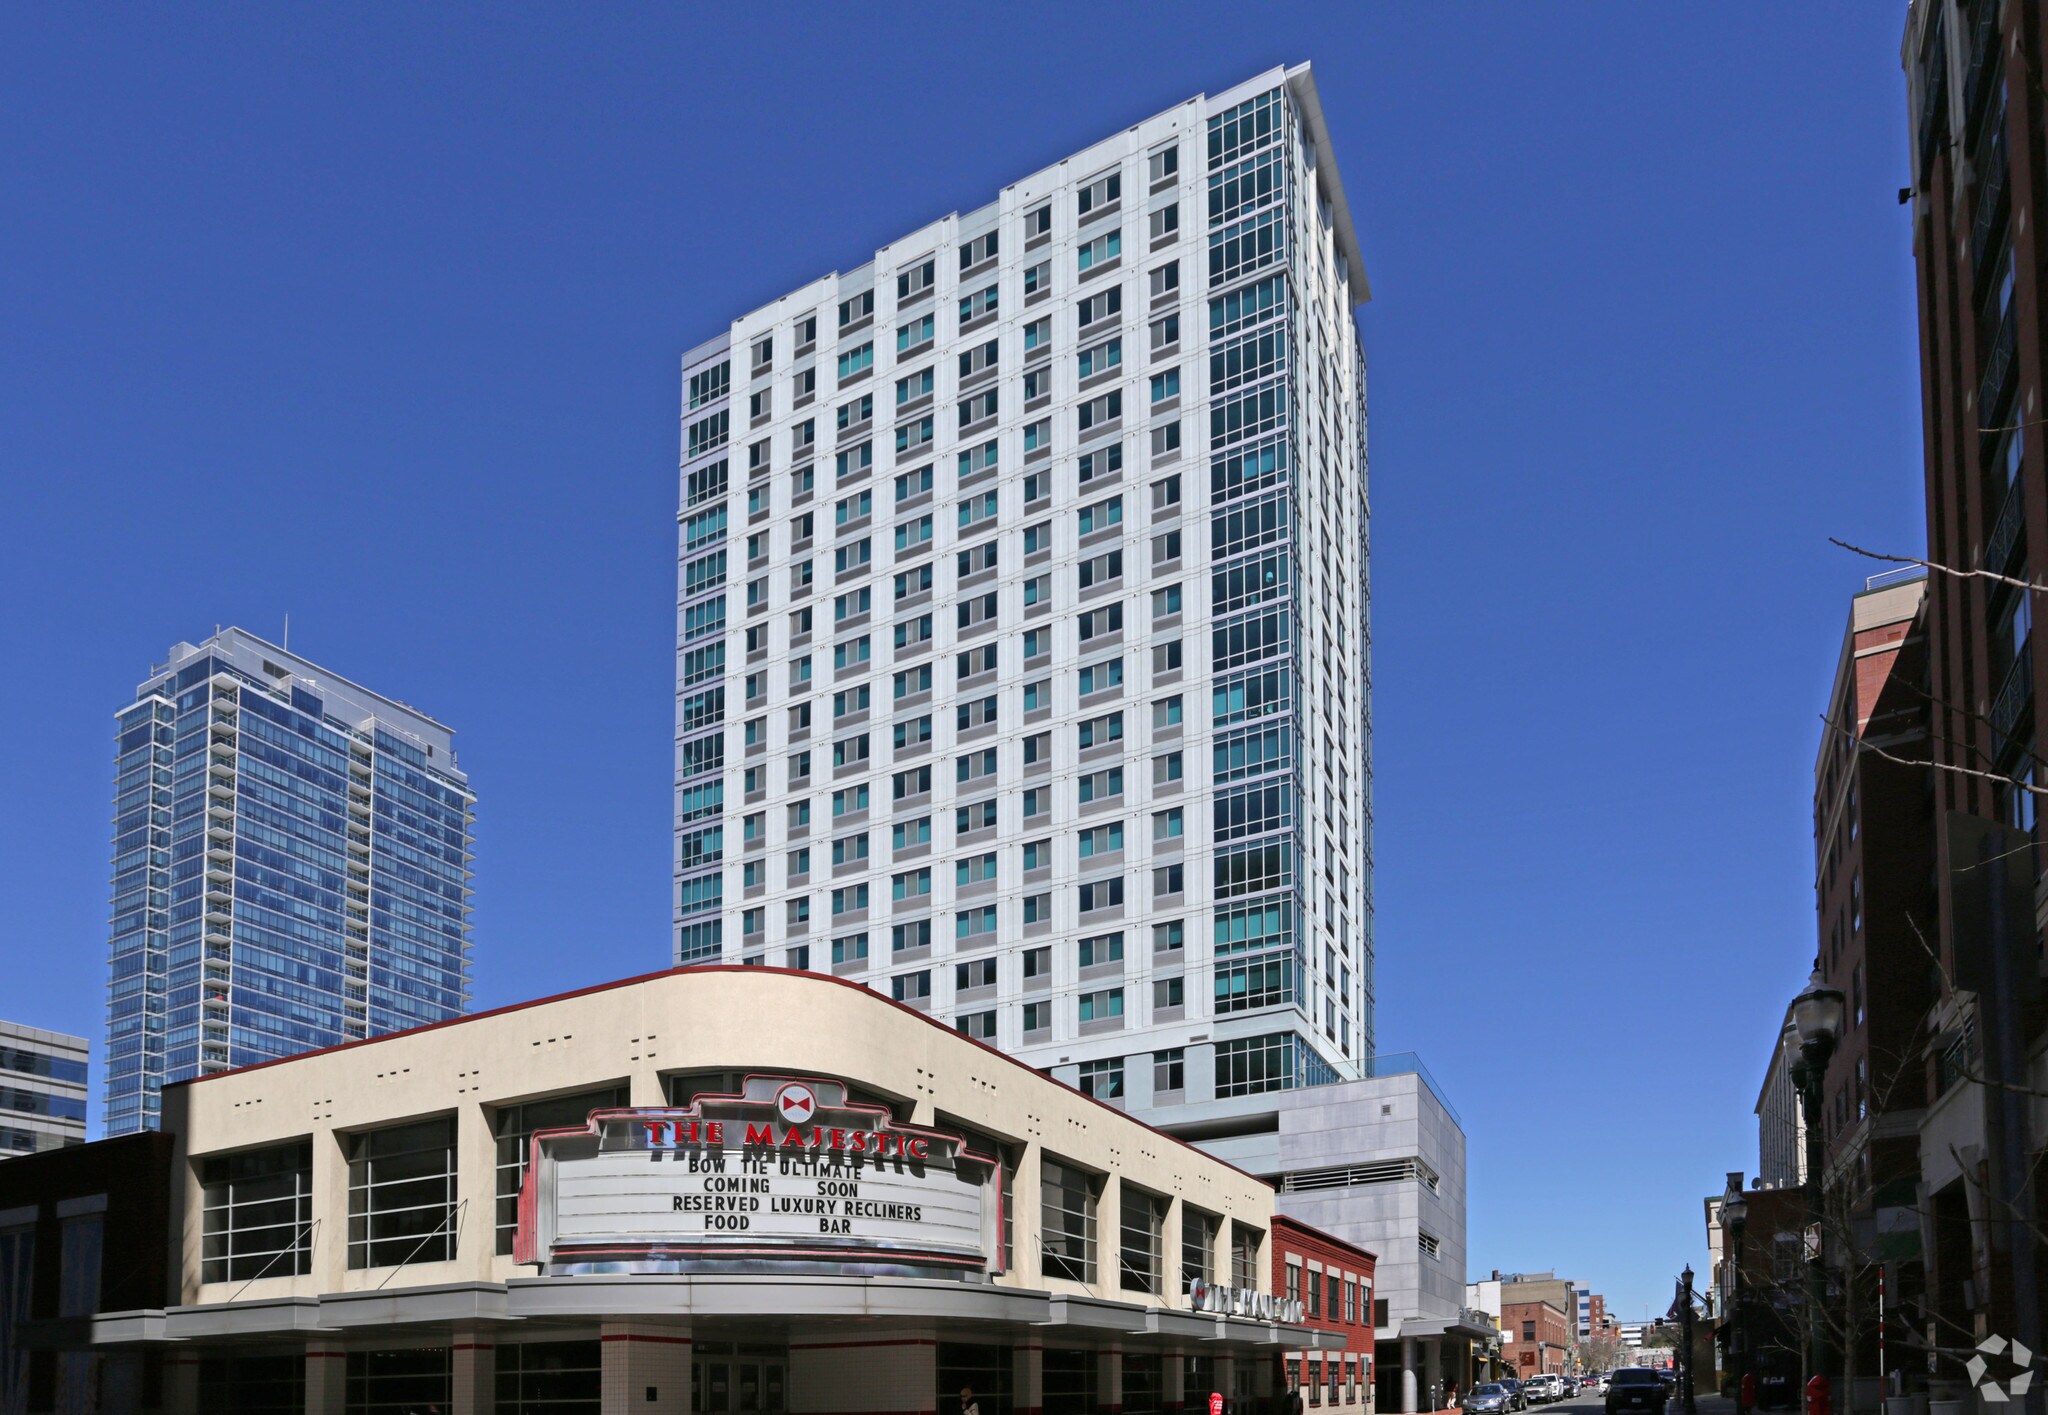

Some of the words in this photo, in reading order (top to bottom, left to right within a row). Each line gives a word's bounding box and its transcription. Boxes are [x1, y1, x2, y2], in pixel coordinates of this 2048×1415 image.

[643, 1121, 724, 1144] THE
[743, 1123, 929, 1159] MAJESTIC
[688, 1158, 726, 1173] BOW
[741, 1160, 768, 1175] TIE
[780, 1161, 862, 1180] ULTIMATE
[703, 1177, 770, 1193] COMING
[817, 1181, 858, 1198] SOON
[673, 1196, 759, 1211] RESERVED
[771, 1197, 837, 1214] LUXURY
[844, 1200, 921, 1221] RECLINERS
[704, 1214, 750, 1230] FOOD
[819, 1218, 851, 1234] BAR
